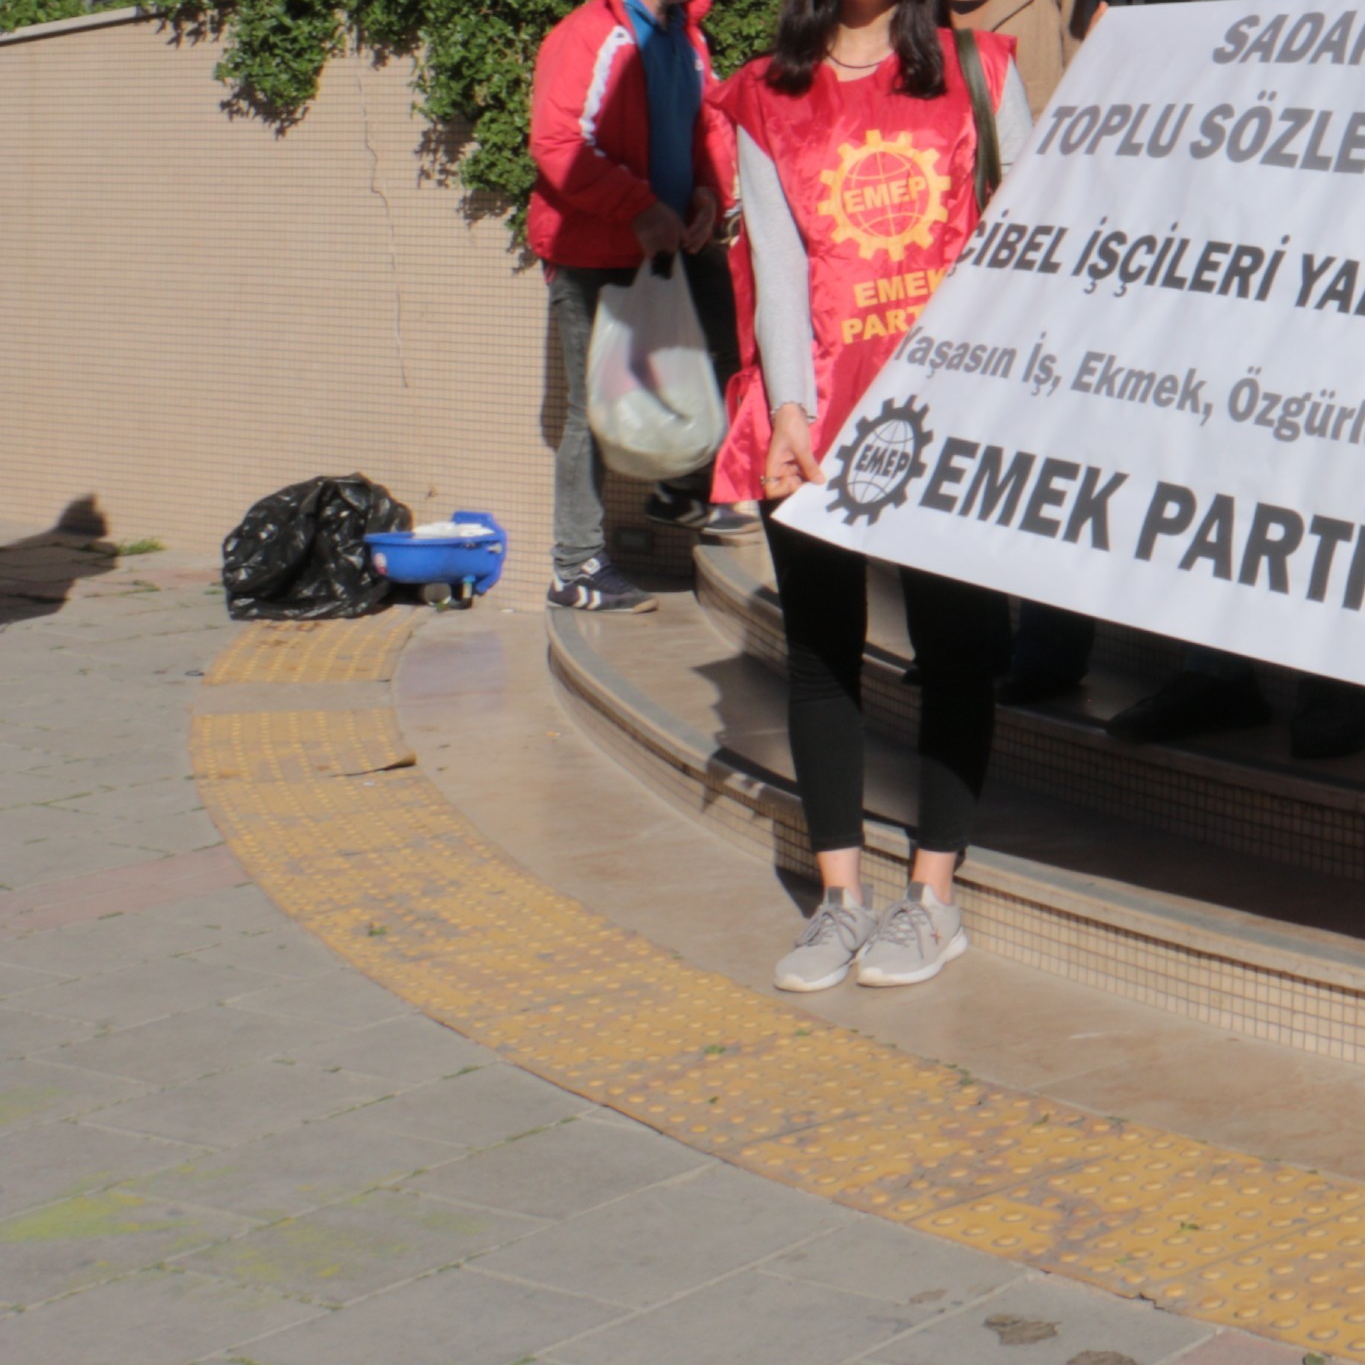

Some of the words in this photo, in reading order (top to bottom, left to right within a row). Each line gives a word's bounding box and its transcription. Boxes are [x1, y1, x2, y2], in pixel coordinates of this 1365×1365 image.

[1035, 102, 1194, 160] TOPLU
[843, 174, 927, 214] EMEP
[1070, 215, 1290, 302] İŞÇİLERİ
[894, 325, 1018, 380] Yaşasın
[1022, 332, 1062, 397] İş,
[1070, 351, 1214, 426] Ekmek,
[854, 444, 911, 481] EMEP
[918, 436, 1131, 552] EMEK
